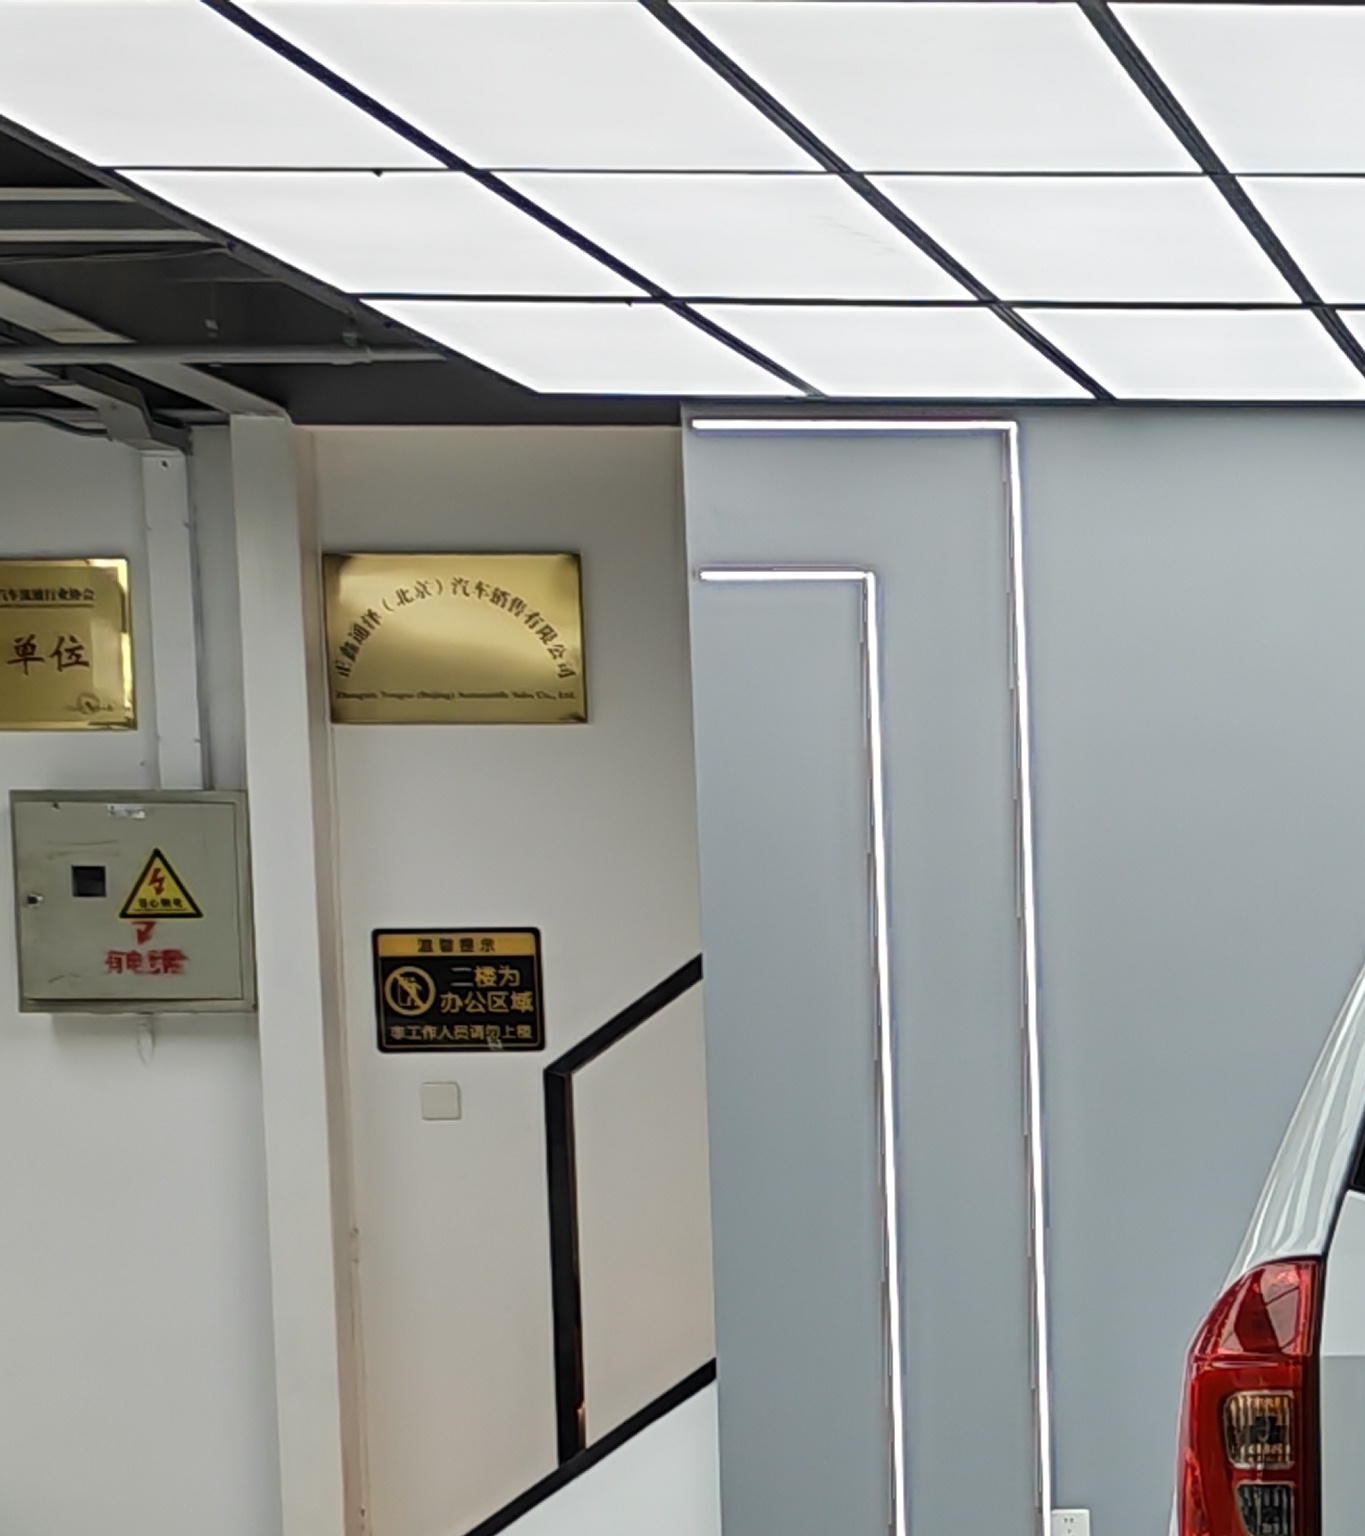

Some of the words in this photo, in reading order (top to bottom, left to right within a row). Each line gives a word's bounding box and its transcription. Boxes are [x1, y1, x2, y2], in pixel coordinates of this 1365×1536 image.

[7, 633, 90, 675] 单位
[450, 964, 520, 987] 二楼为
[439, 991, 534, 1013] 办公区域
